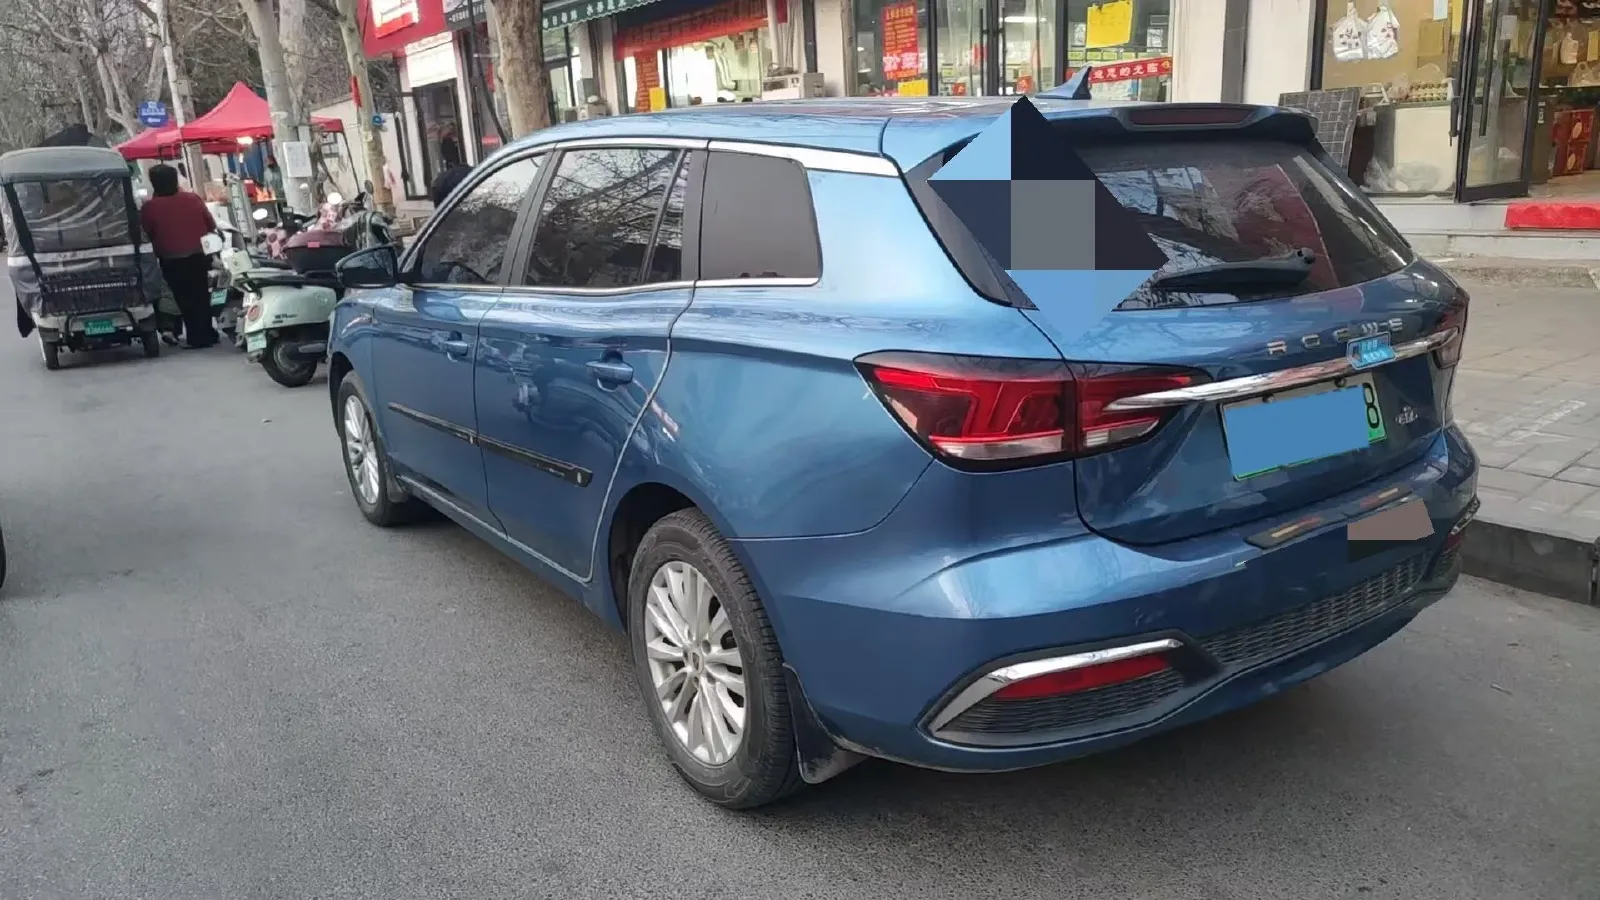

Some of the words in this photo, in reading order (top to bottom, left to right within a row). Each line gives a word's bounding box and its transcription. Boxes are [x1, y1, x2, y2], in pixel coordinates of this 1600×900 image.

[1088, 62, 1159, 81] 迎您的光临
